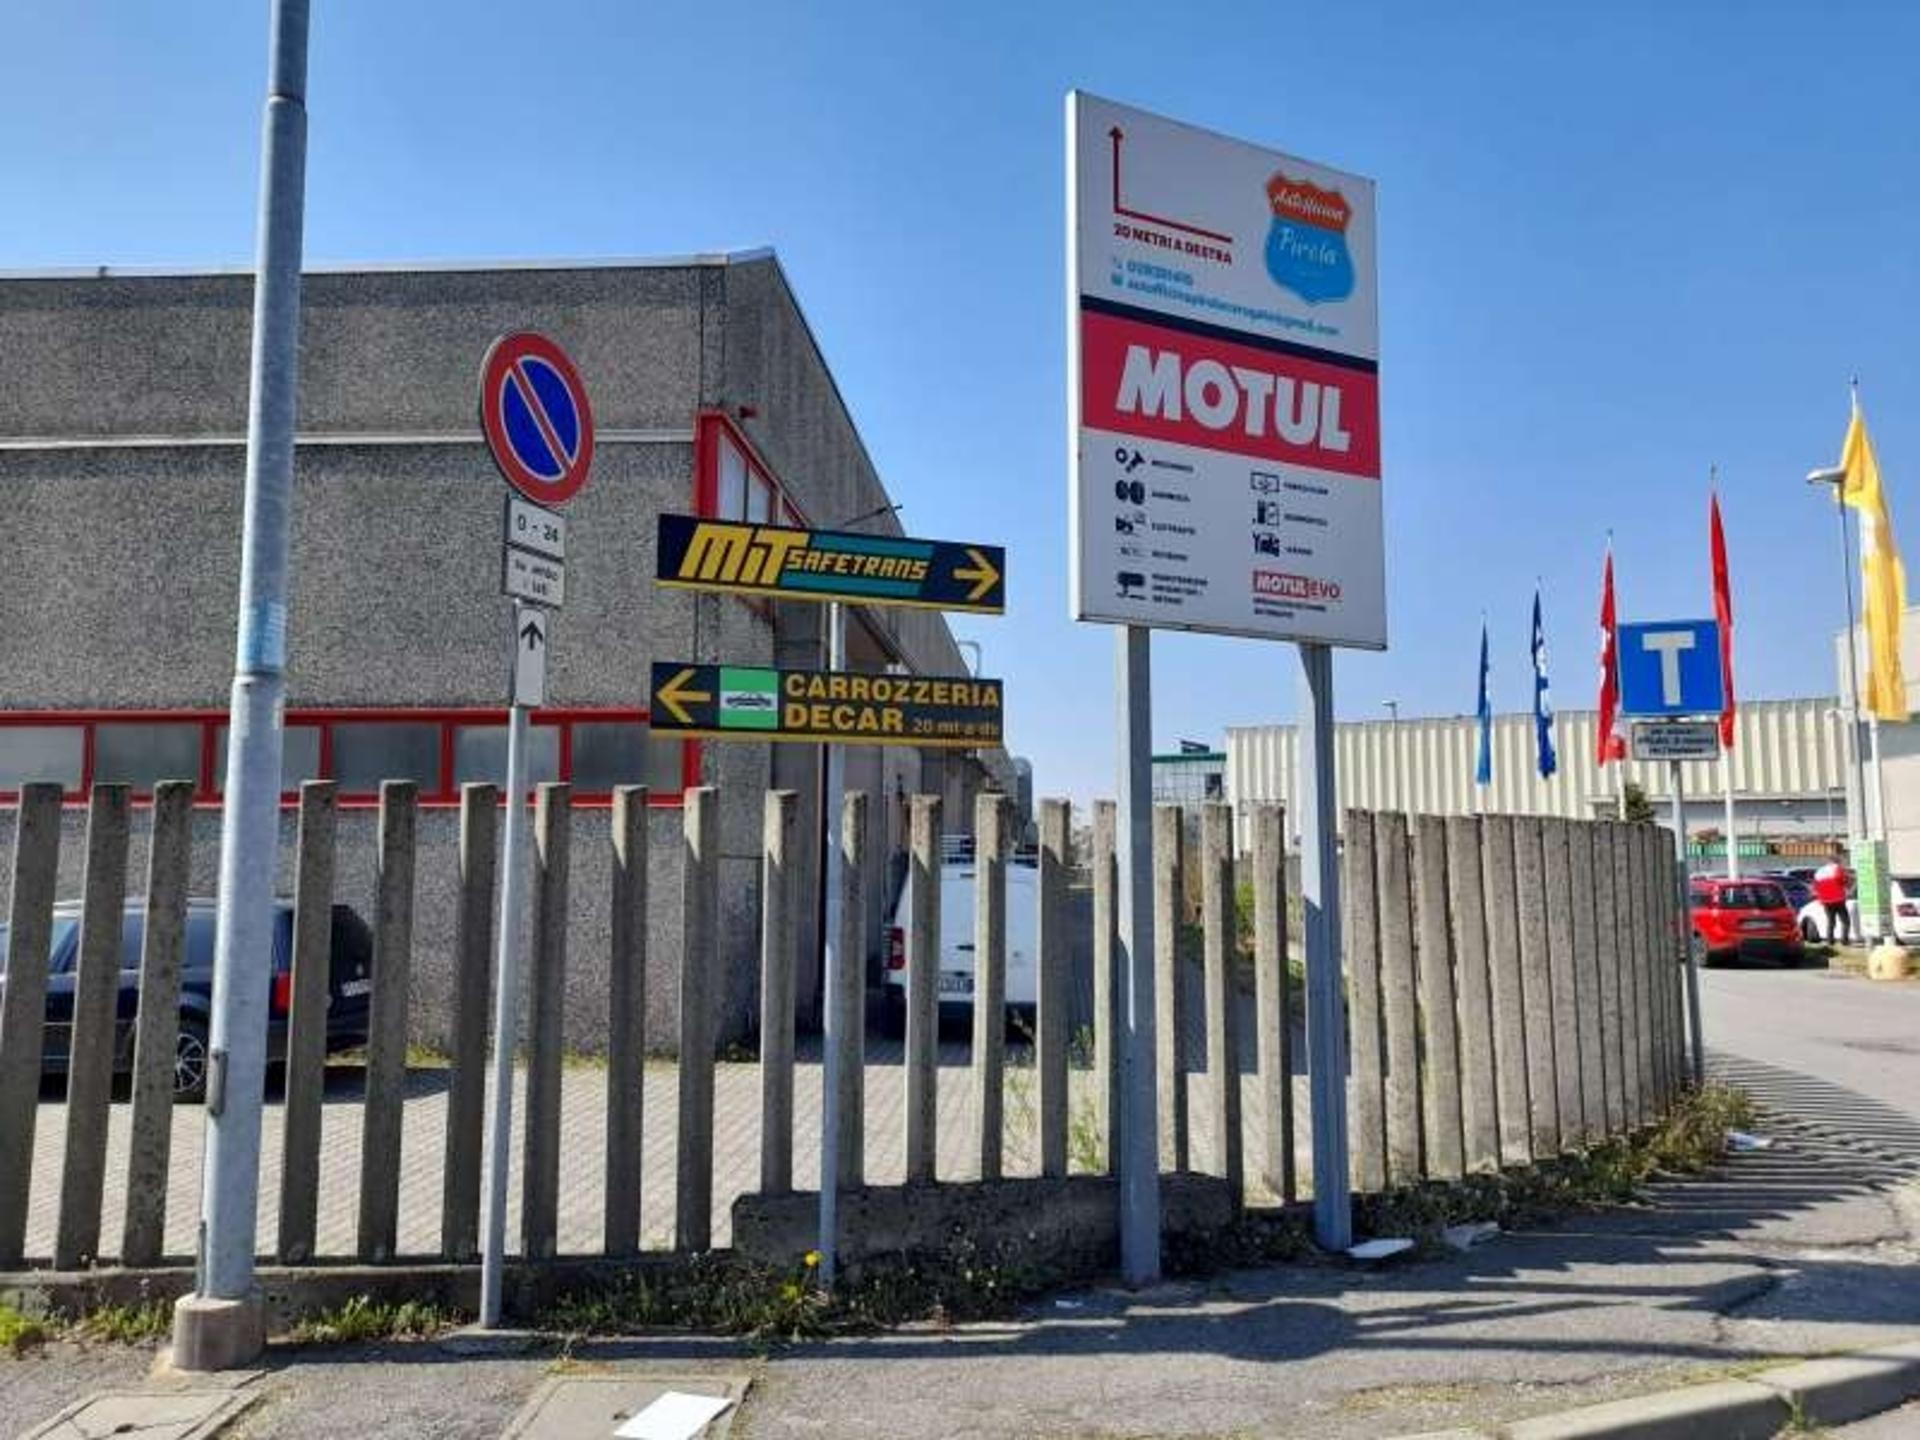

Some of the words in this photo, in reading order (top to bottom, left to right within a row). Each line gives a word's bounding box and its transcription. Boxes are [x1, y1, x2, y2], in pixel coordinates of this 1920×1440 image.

[1113, 223, 1131, 239] 20
[1132, 227, 1172, 249] METRI
[1116, 345, 1352, 452] MOTUL
[543, 525, 558, 543] 24
[786, 549, 929, 580] SAFETRANS
[1257, 574, 1306, 597] MOTUL
[785, 673, 999, 708] CARROZZERIA
[784, 702, 904, 732] DECAR
[912, 718, 933, 733] 20
